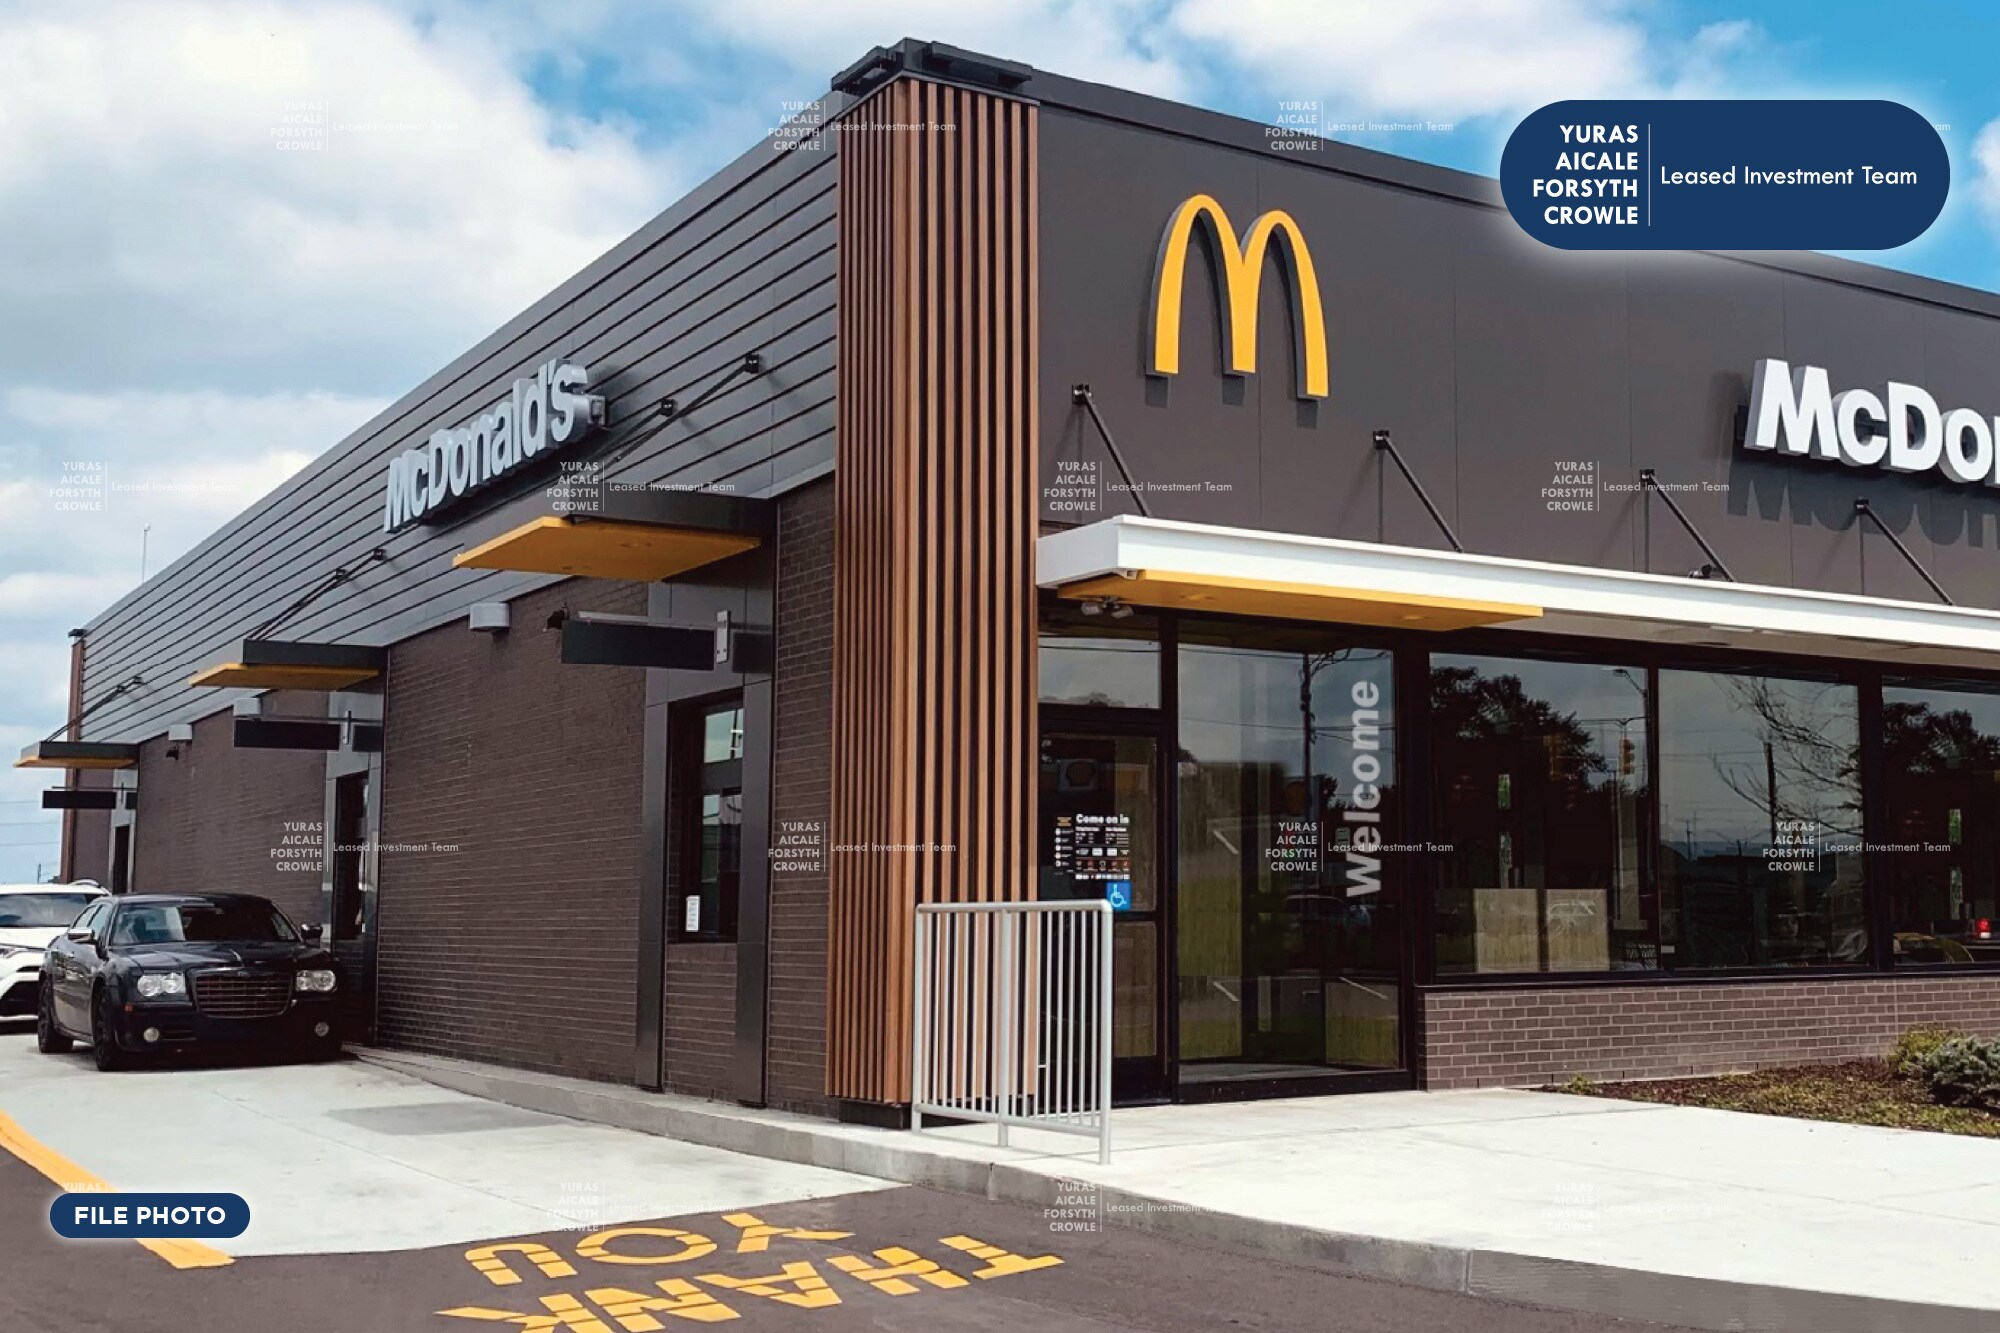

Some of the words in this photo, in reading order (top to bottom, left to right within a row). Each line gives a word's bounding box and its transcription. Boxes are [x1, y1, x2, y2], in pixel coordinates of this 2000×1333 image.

[384, 358, 590, 533] McDonald's
[1744, 358, 2000, 487] McDo
[1076, 814, 1104, 824] Come
[1105, 816, 1118, 824] on
[433, 1234, 1066, 1333] THANK
[464, 1212, 855, 1286] YOU
